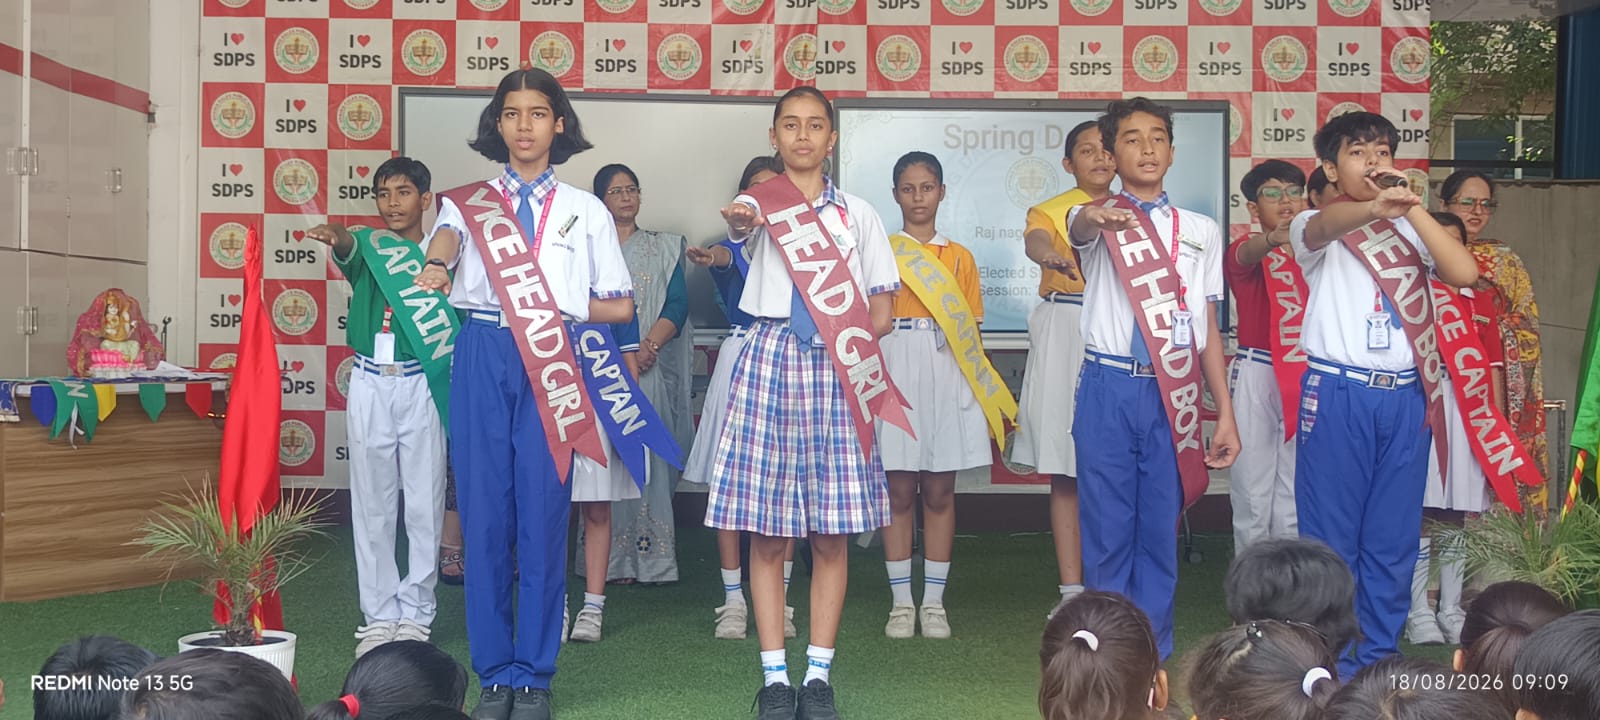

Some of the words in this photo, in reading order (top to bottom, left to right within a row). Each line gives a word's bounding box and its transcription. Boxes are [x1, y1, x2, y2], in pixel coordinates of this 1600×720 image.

[213, 52, 255, 67] SDPS
[339, 54, 382, 69] SDPS
[467, 56, 510, 71] SDPS
[594, 58, 637, 73] SDPS
[721, 59, 764, 74] SDPS
[816, 60, 856, 75] SDPS
[941, 61, 984, 76] SDPS
[1069, 61, 1112, 76] SDPS
[1198, 61, 1242, 76] SDPS
[1328, 62, 1371, 77] SDPS
[275, 118, 317, 134] SDPS
[943, 123, 1035, 155] Spring
[1263, 127, 1306, 142] SDPS
[211, 183, 254, 198] SDPS
[975, 226, 995, 241] Raj
[274, 249, 316, 264] SDPS
[896, 242, 947, 293] VICE
[979, 266, 1025, 279] Elected
[767, 203, 855, 316] HEAD
[835, 327, 888, 424] GIRL
[1267, 251, 1308, 362] APTAIN
[1346, 219, 1428, 325] HEAD
[1414, 323, 1443, 402] BOY
[210, 313, 242, 328] SDP
[465, 187, 527, 264] VICE
[500, 261, 565, 358] HEAD
[540, 361, 587, 443] GIRL
[1170, 382, 1199, 453] BOY
[1454, 347, 1524, 476] CAPTAIN
